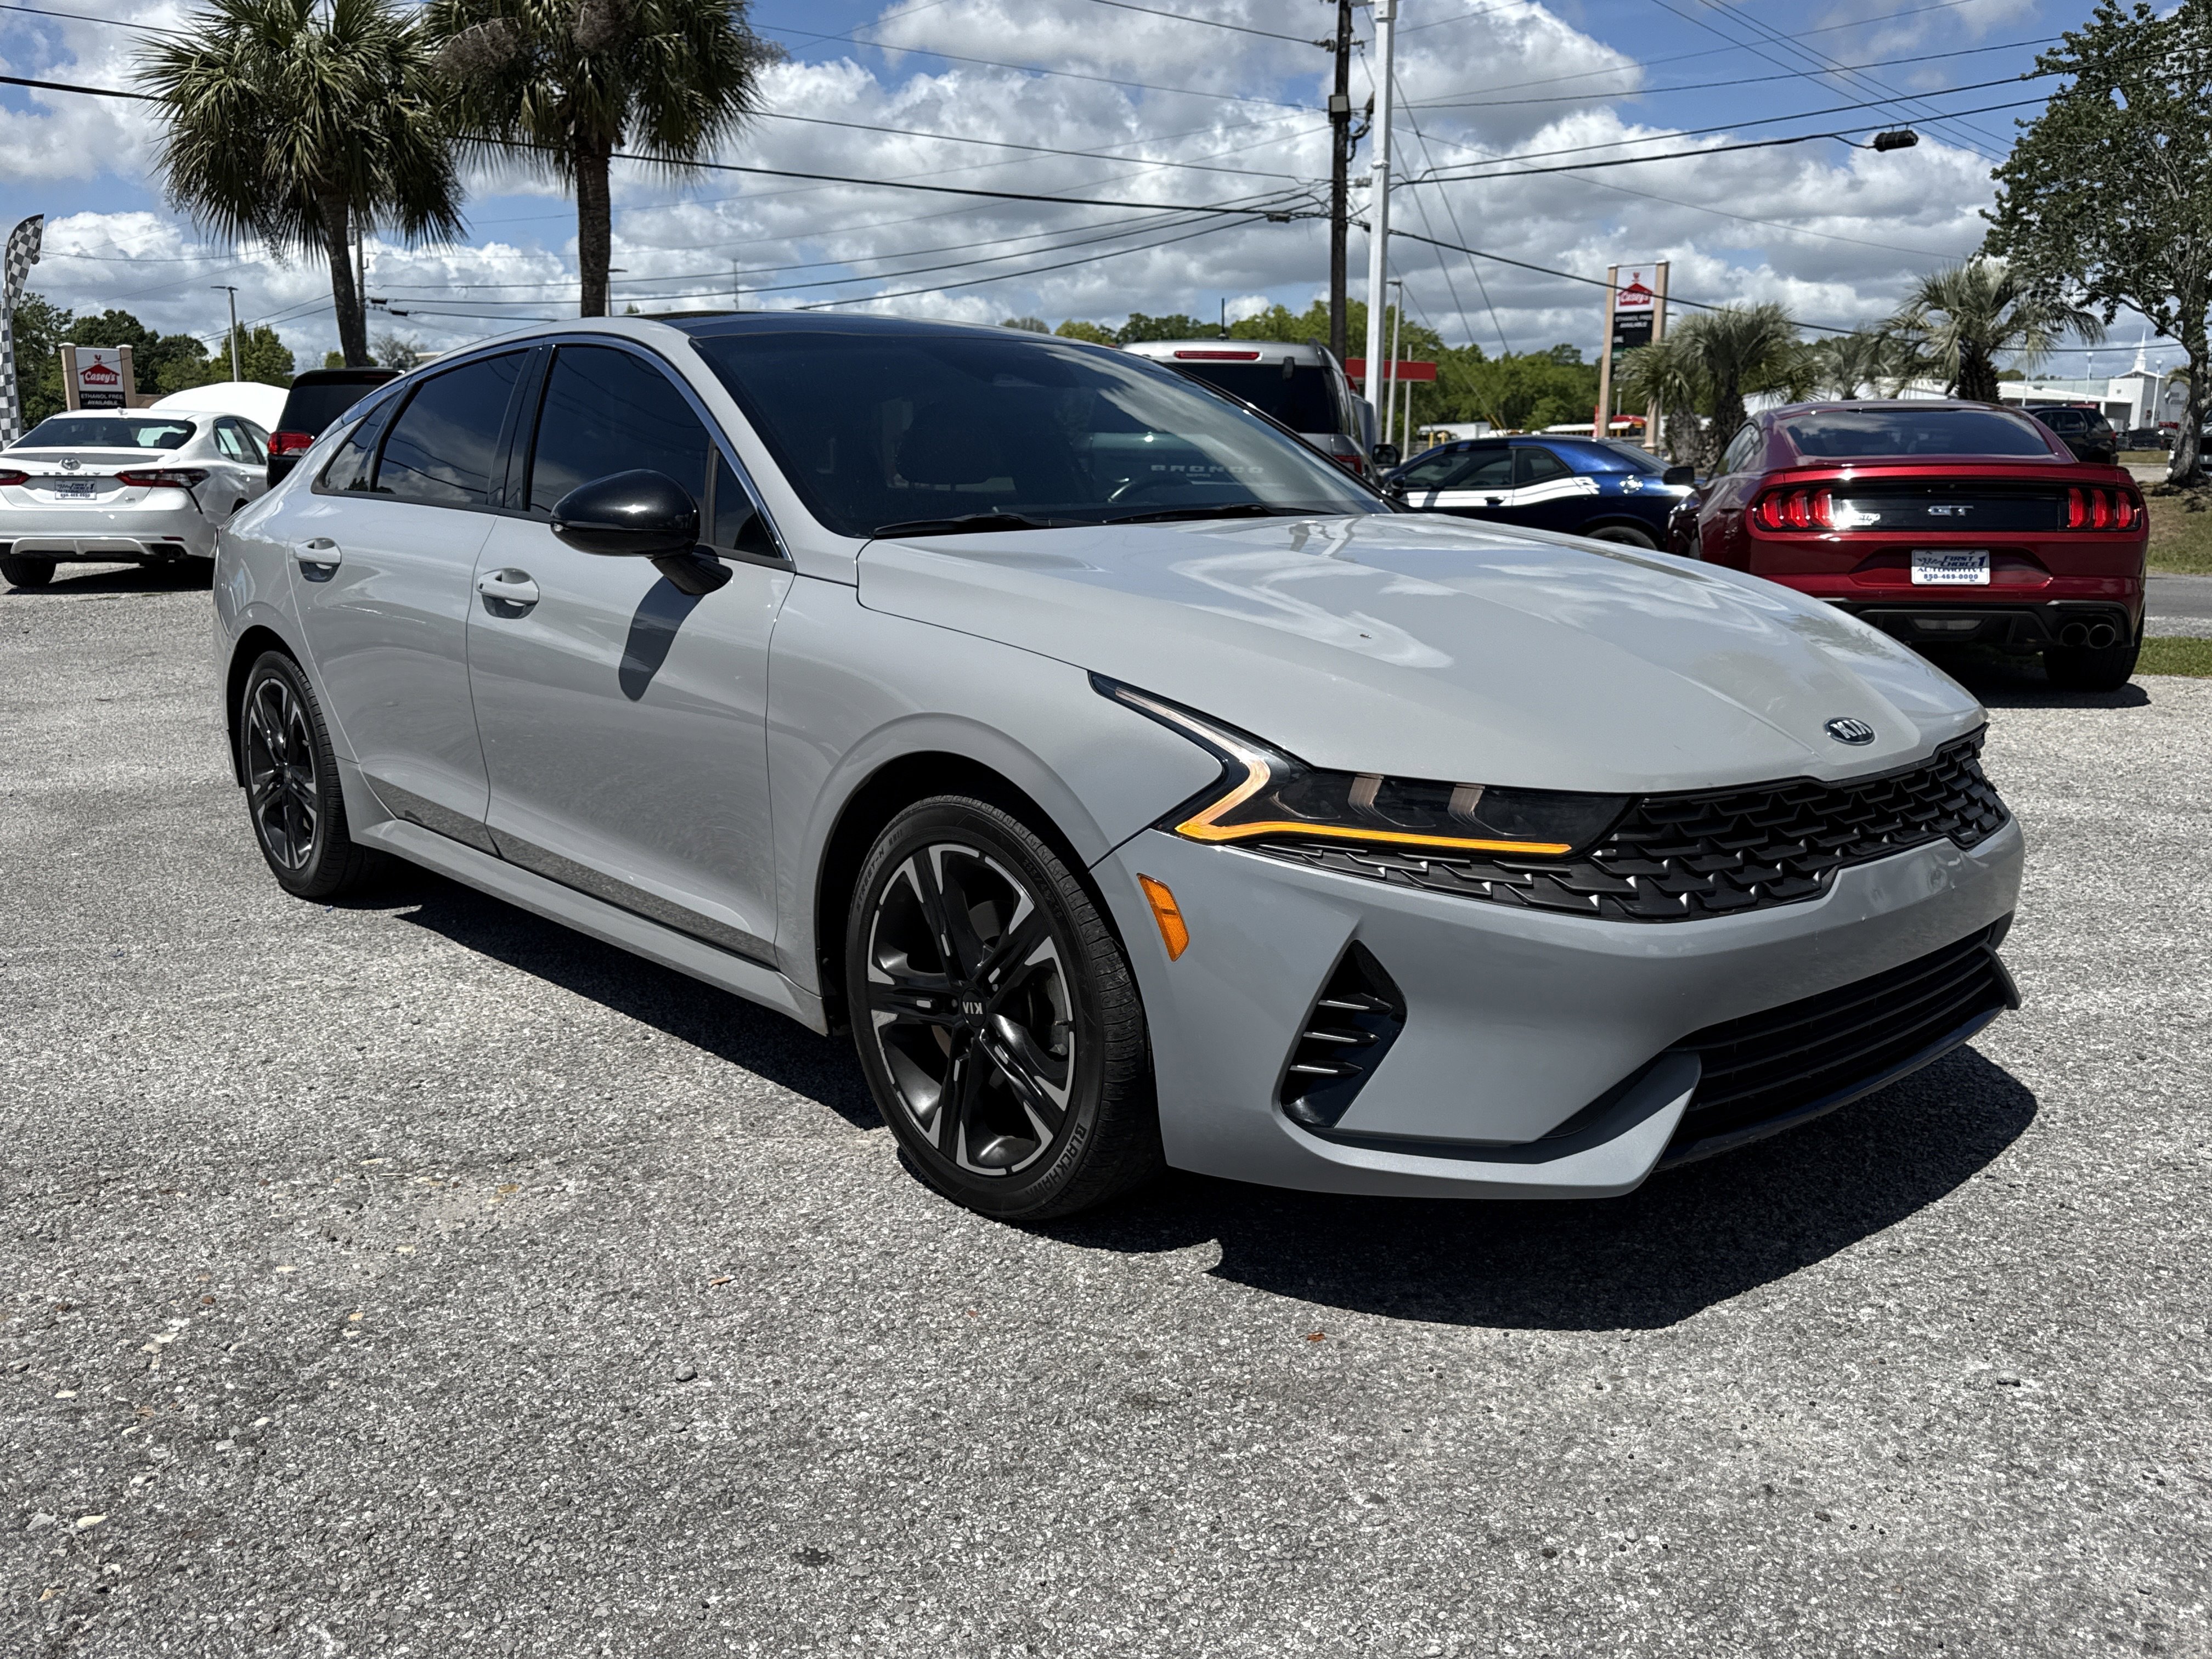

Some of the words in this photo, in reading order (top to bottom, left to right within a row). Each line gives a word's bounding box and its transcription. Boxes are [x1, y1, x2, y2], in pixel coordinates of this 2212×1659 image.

[84, 371, 116, 383] Casey's
[1151, 465, 1263, 473] BRONCO
[1928, 505, 1974, 517] GT
[1830, 719, 1872, 738] KIA
[962, 1001, 984, 1014] KIA
[1025, 1122, 1087, 1198] BLACKHAWK
